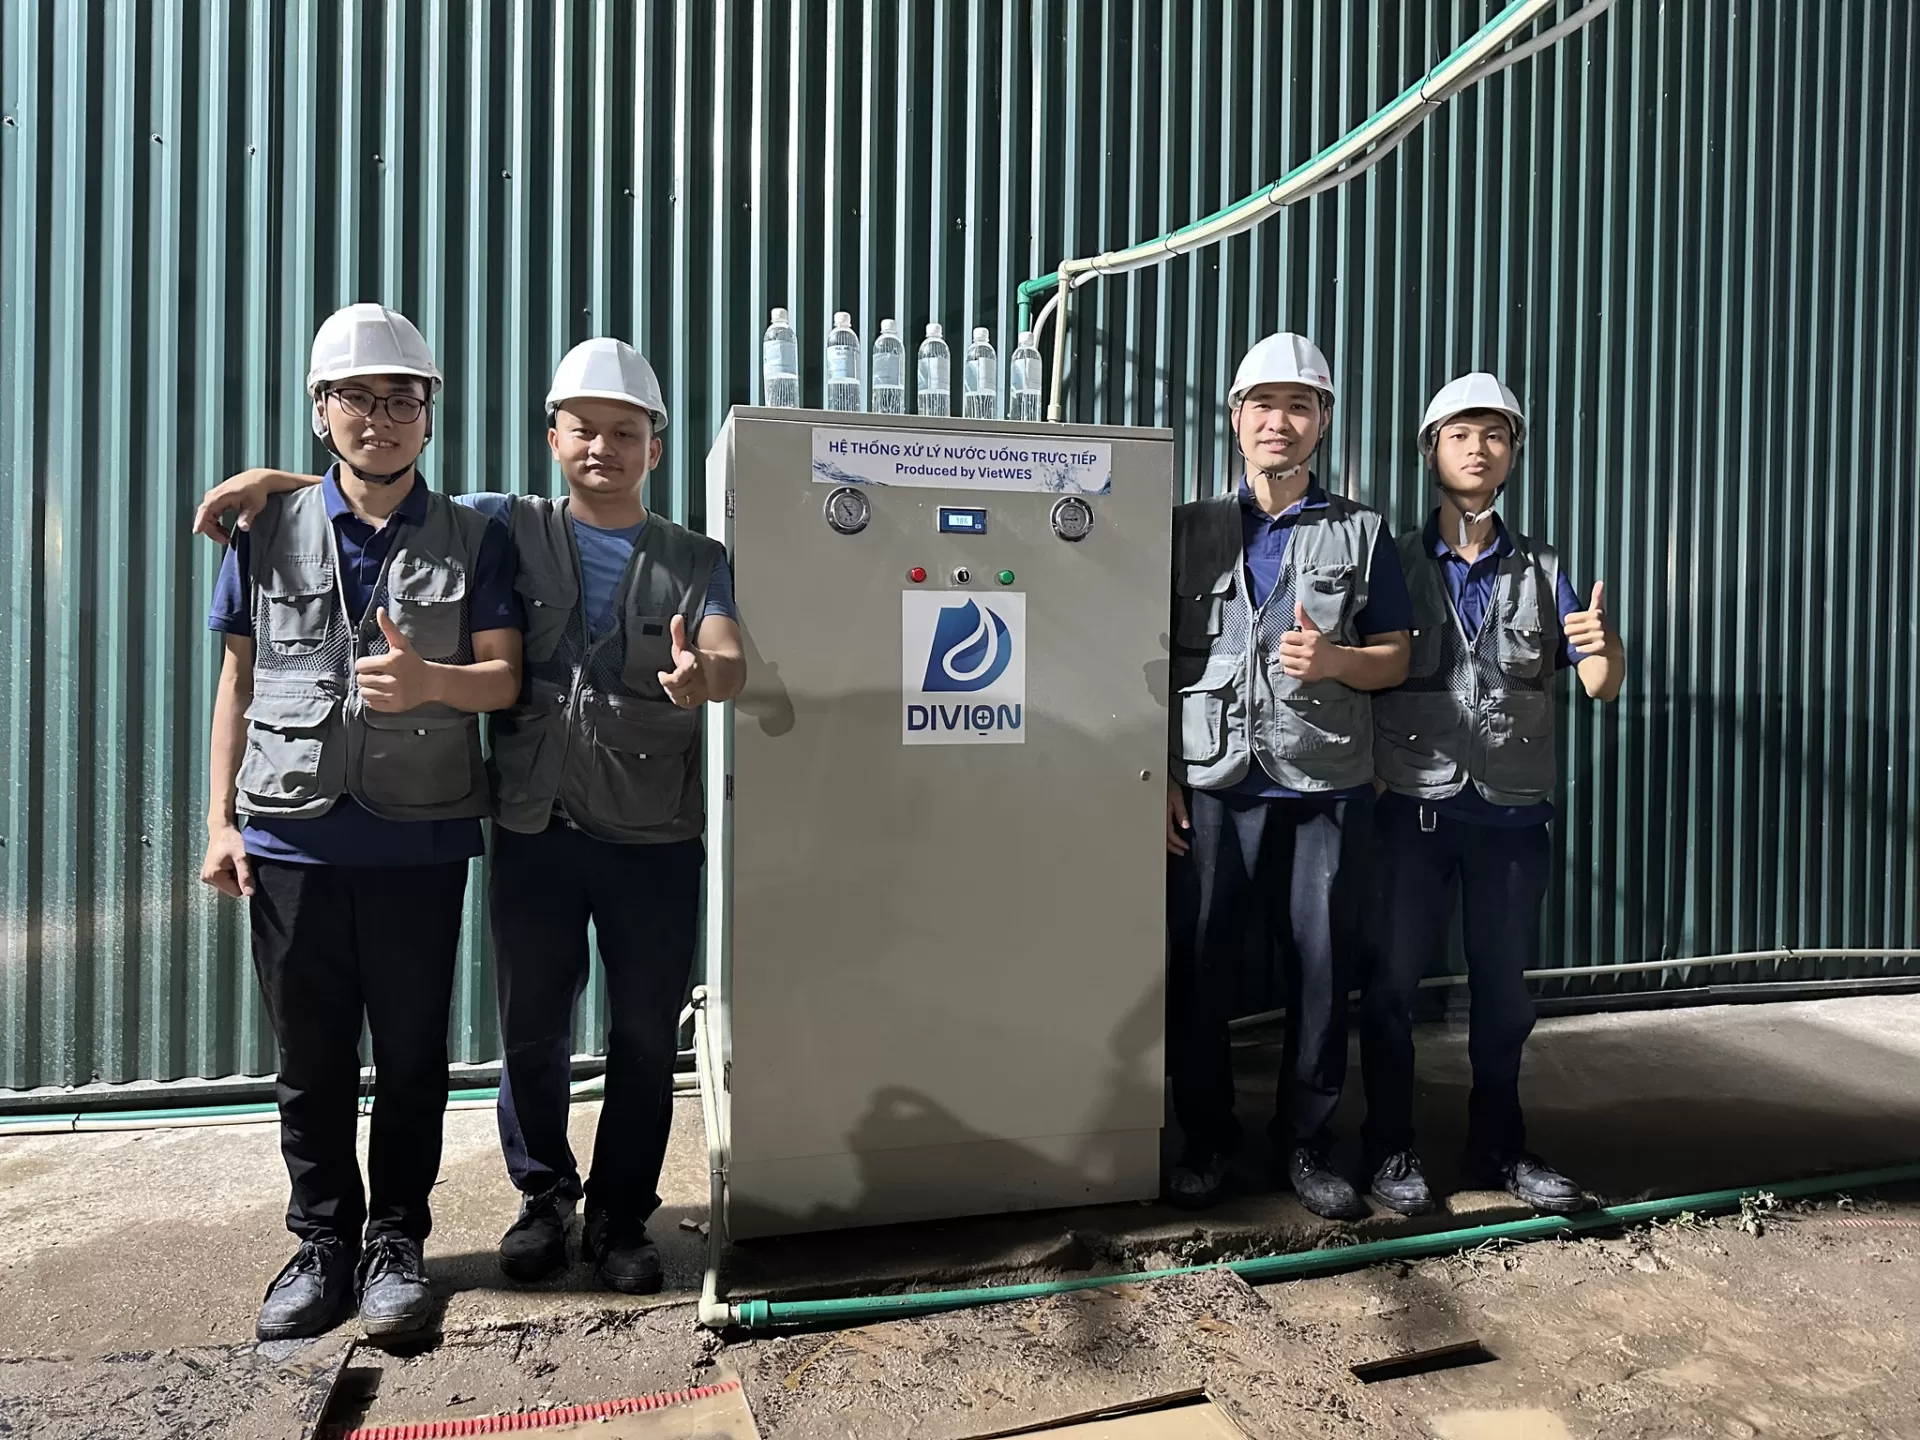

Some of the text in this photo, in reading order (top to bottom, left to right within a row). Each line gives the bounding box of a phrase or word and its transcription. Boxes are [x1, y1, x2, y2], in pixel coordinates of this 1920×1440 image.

[829, 438, 1097, 465] HỆ THỐNG XỬ LÝ NƯỚC UỐNG TRỰC TIẾP
[895, 462, 1032, 480] Produced by VietWES
[907, 704, 1022, 735] DIVION
